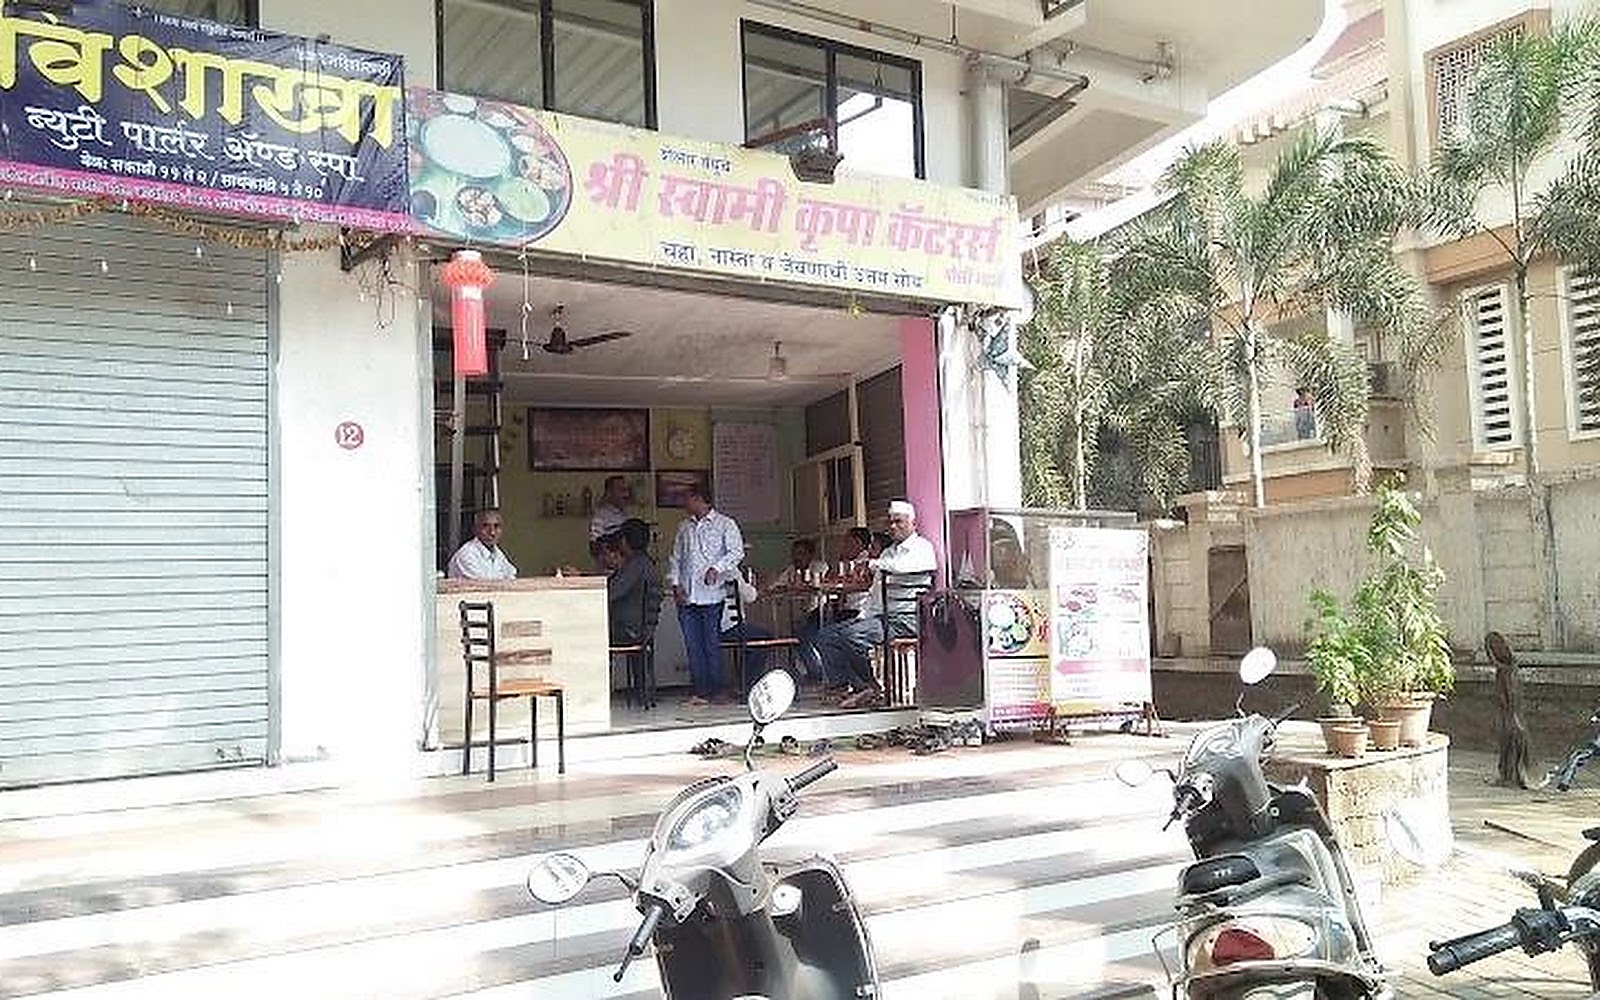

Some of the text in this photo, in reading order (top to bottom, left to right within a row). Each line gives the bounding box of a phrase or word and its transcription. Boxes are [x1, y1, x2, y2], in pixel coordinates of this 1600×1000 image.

[120, 119, 215, 161] पार्लर
[307, 149, 366, 183] स्पा
[304, 185, 323, 199] १०
[583, 152, 648, 213] श्री
[659, 173, 786, 233] स्वामी
[795, 199, 881, 253] कृपा
[340, 425, 360, 446] 12
